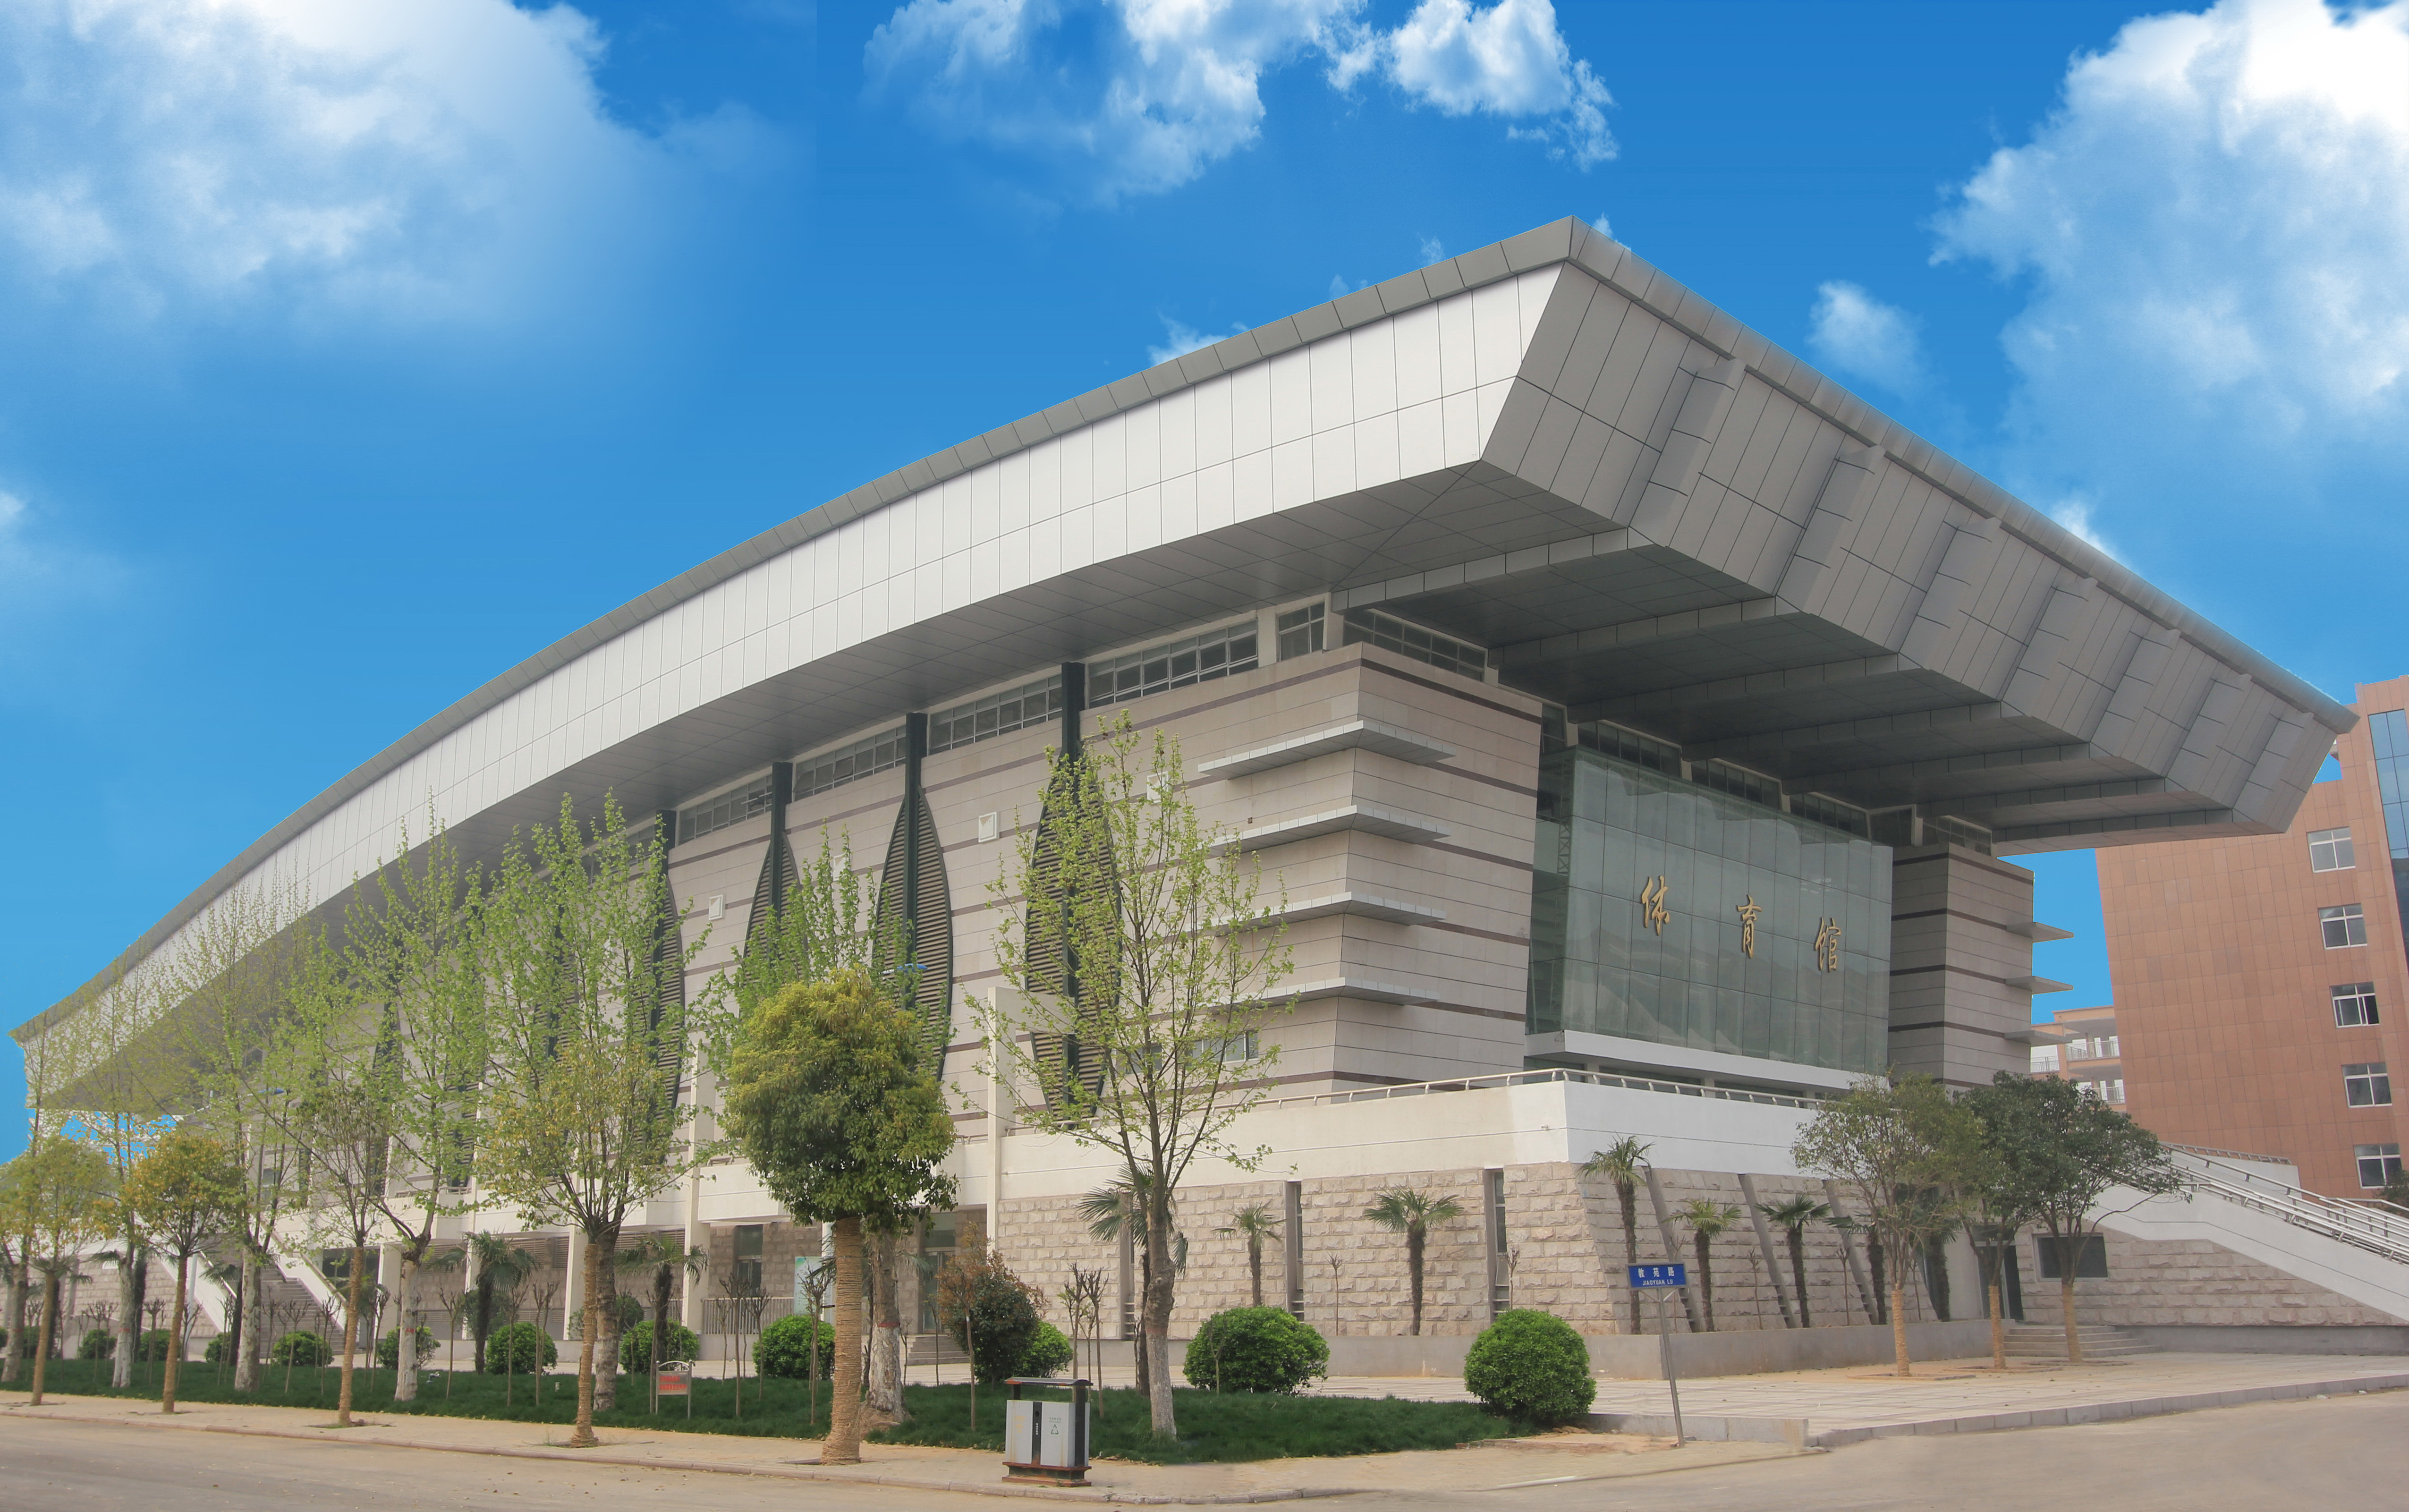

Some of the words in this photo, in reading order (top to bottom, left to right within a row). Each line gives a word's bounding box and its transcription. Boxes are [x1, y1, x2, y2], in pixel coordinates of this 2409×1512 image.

[1641, 875, 1841, 973] 体育馆
[1638, 1267, 1674, 1278] 教苑路
